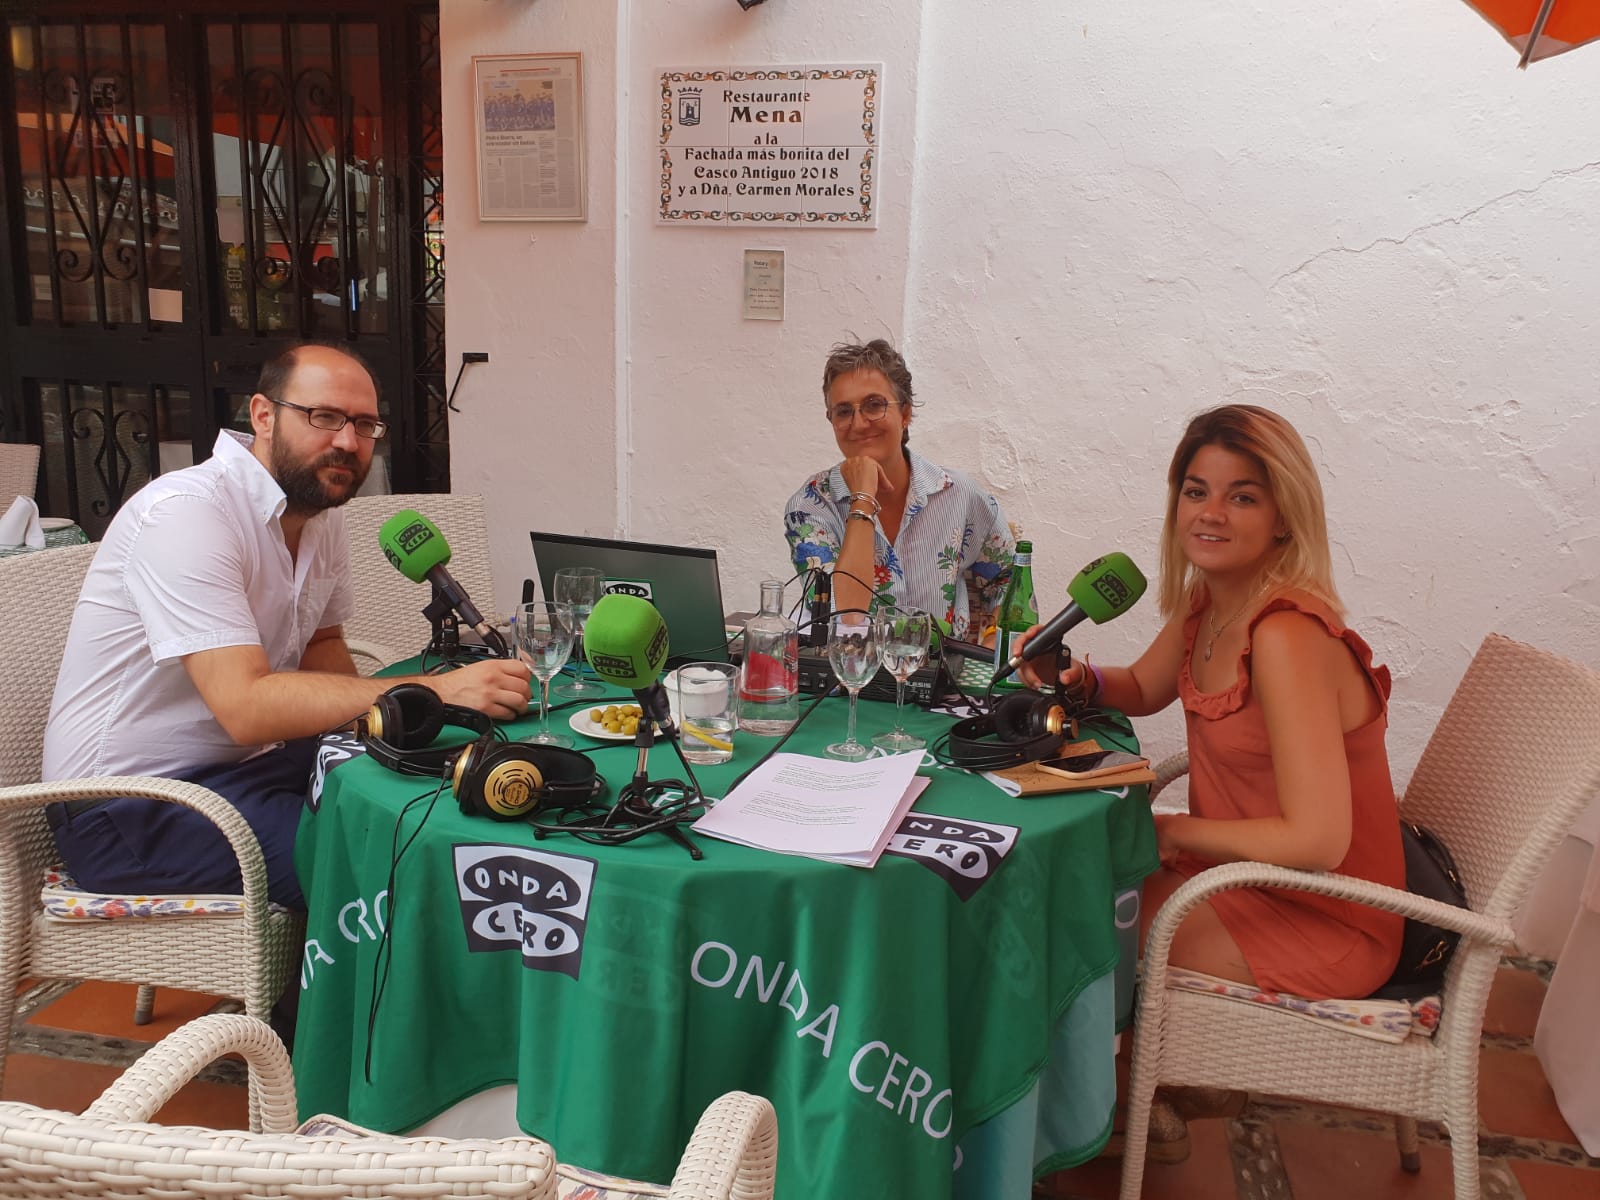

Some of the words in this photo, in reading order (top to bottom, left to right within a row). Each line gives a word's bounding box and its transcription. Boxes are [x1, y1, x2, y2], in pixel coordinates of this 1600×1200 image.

[723, 90, 810, 103] Restaurante
[730, 106, 802, 123] Mena
[753, 135, 762, 145] a
[765, 132, 778, 145] la
[685, 147, 743, 160] Fachada
[747, 147, 775, 160] más
[780, 148, 823, 161] bonita
[827, 148, 849, 161] del
[694, 166, 738, 179] Casco
[741, 166, 796, 181] Antiguo
[801, 167, 839, 180] 2018
[678, 186, 685, 197] y
[689, 185, 697, 195] a
[736, 183, 791, 196] Carmen
[796, 183, 855, 197] Morales
[609, 587, 646, 596] ONDA
[908, 821, 990, 841] NDA
[888, 838, 980, 870] ERO
[474, 867, 568, 902] ONDA
[487, 909, 565, 950] CERO
[690, 941, 840, 1058] ONDA
